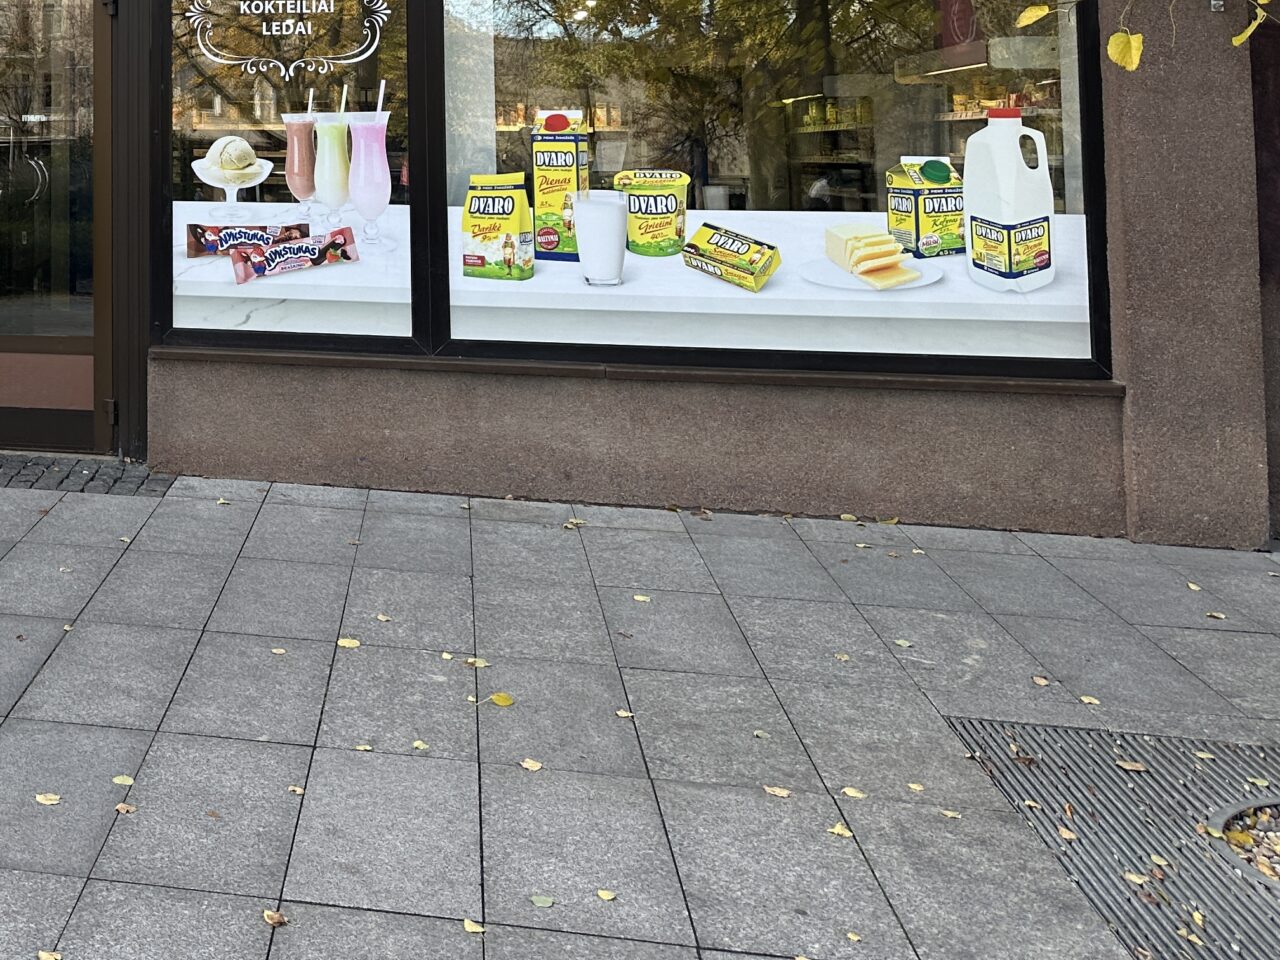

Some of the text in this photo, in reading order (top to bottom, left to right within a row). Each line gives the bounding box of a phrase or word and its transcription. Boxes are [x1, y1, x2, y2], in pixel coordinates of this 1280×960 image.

[239, 0, 335, 14] KOKTEILIAI
[262, 21, 312, 35] LEDAI
[536, 151, 573, 167] DVARO
[470, 196, 514, 214] DVARO
[628, 194, 677, 214] DVARO
[924, 196, 964, 213] DVARO
[975, 224, 1004, 243] DVARO
[1014, 225, 1045, 244] DVARO
[707, 232, 750, 255] DVARO
